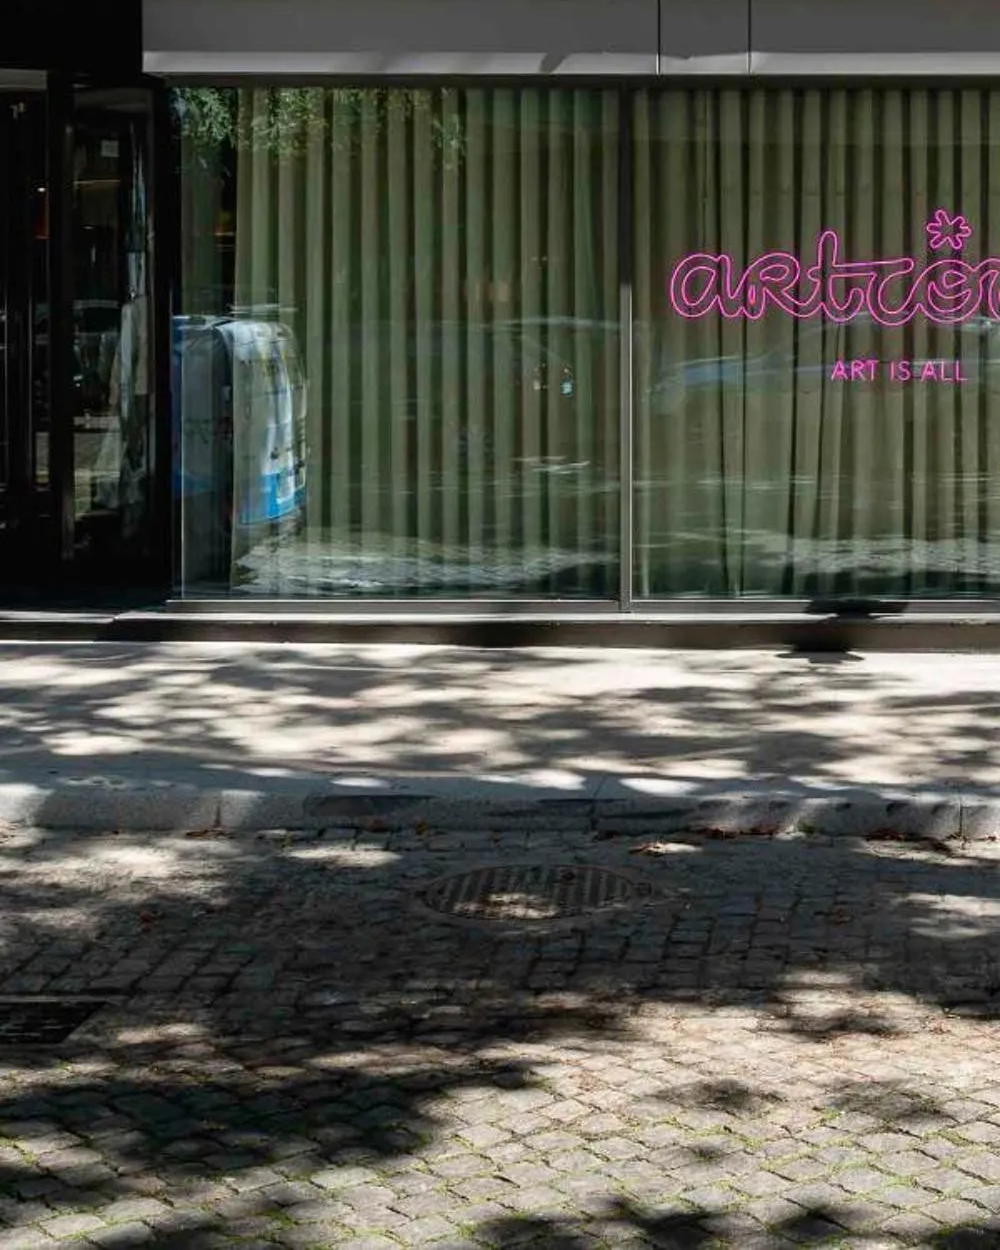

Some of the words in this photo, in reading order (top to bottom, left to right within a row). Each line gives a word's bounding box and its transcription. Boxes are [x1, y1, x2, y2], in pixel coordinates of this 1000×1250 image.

[830, 358, 879, 381] ART
[889, 359, 912, 381] IS
[921, 358, 969, 381] ALL
